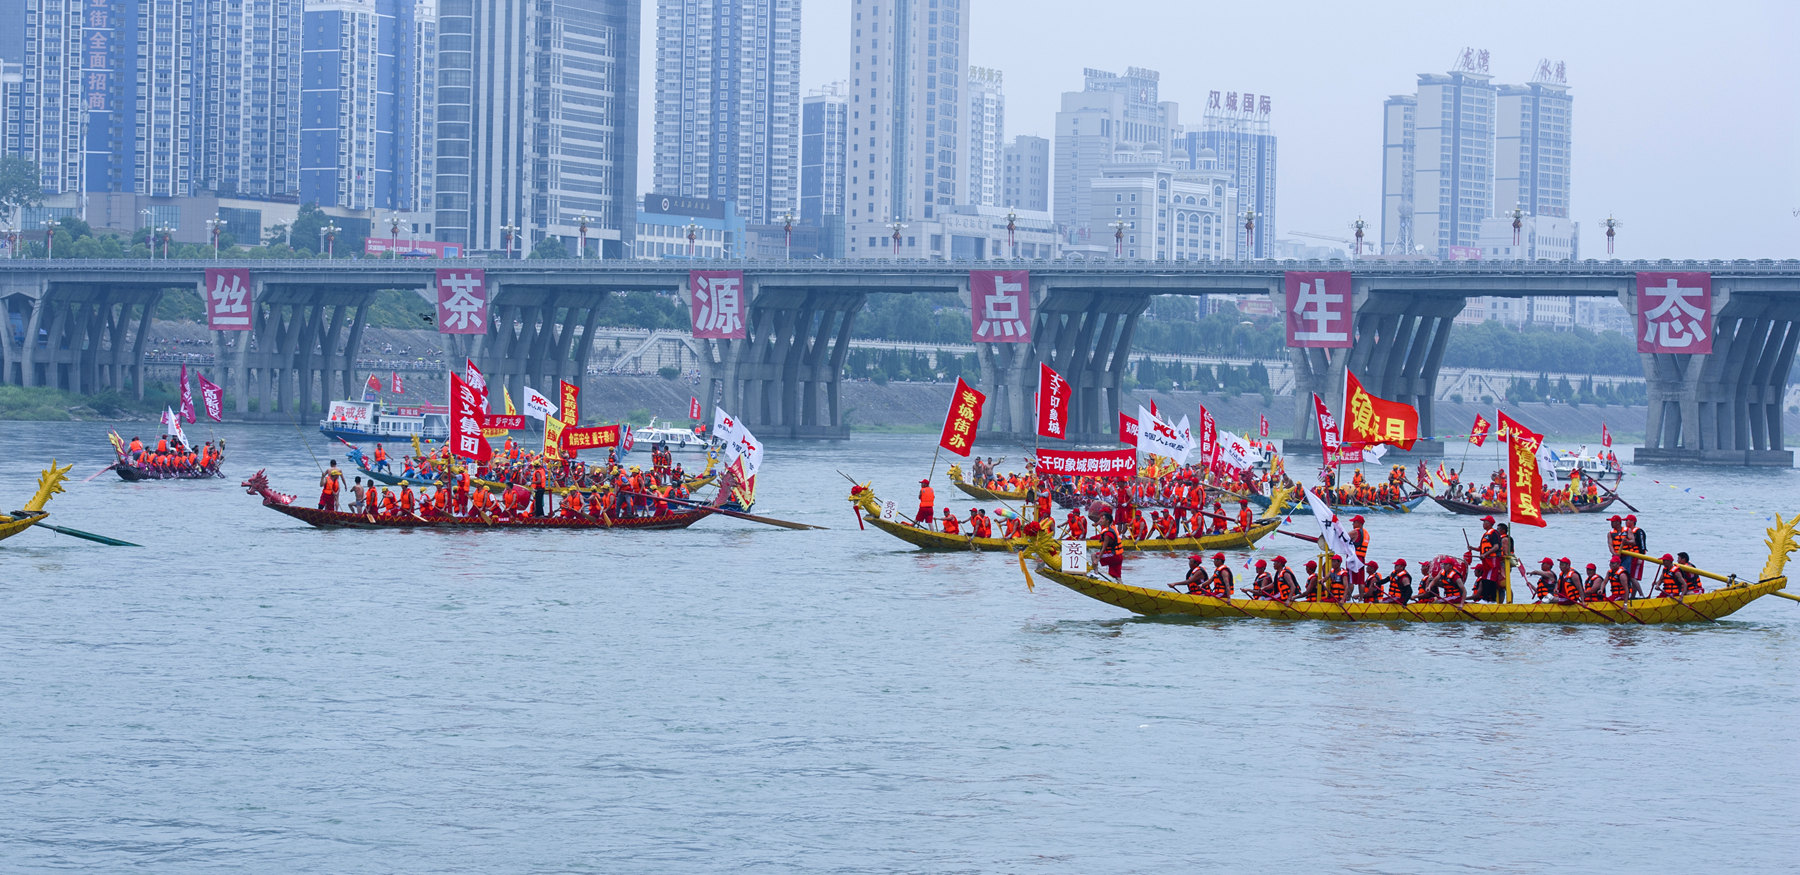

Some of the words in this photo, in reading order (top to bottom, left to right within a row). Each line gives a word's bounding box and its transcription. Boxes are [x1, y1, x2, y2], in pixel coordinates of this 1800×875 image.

[1209, 90, 1272, 115] 汉城国际
[211, 274, 249, 325] 丝
[441, 273, 485, 330] 茶
[695, 275, 742, 334] 源
[976, 275, 1027, 337] 点
[1293, 277, 1348, 342] 生
[1643, 278, 1707, 348] 态
[335, 405, 367, 420] 警戒线
[949, 390, 977, 448] 老城街办
[1048, 373, 1063, 435] 大千印象城
[1153, 420, 1177, 440] PICC
[884, 509, 893, 519] 3
[1066, 542, 1083, 556] 竞
[1070, 555, 1080, 569] 12
